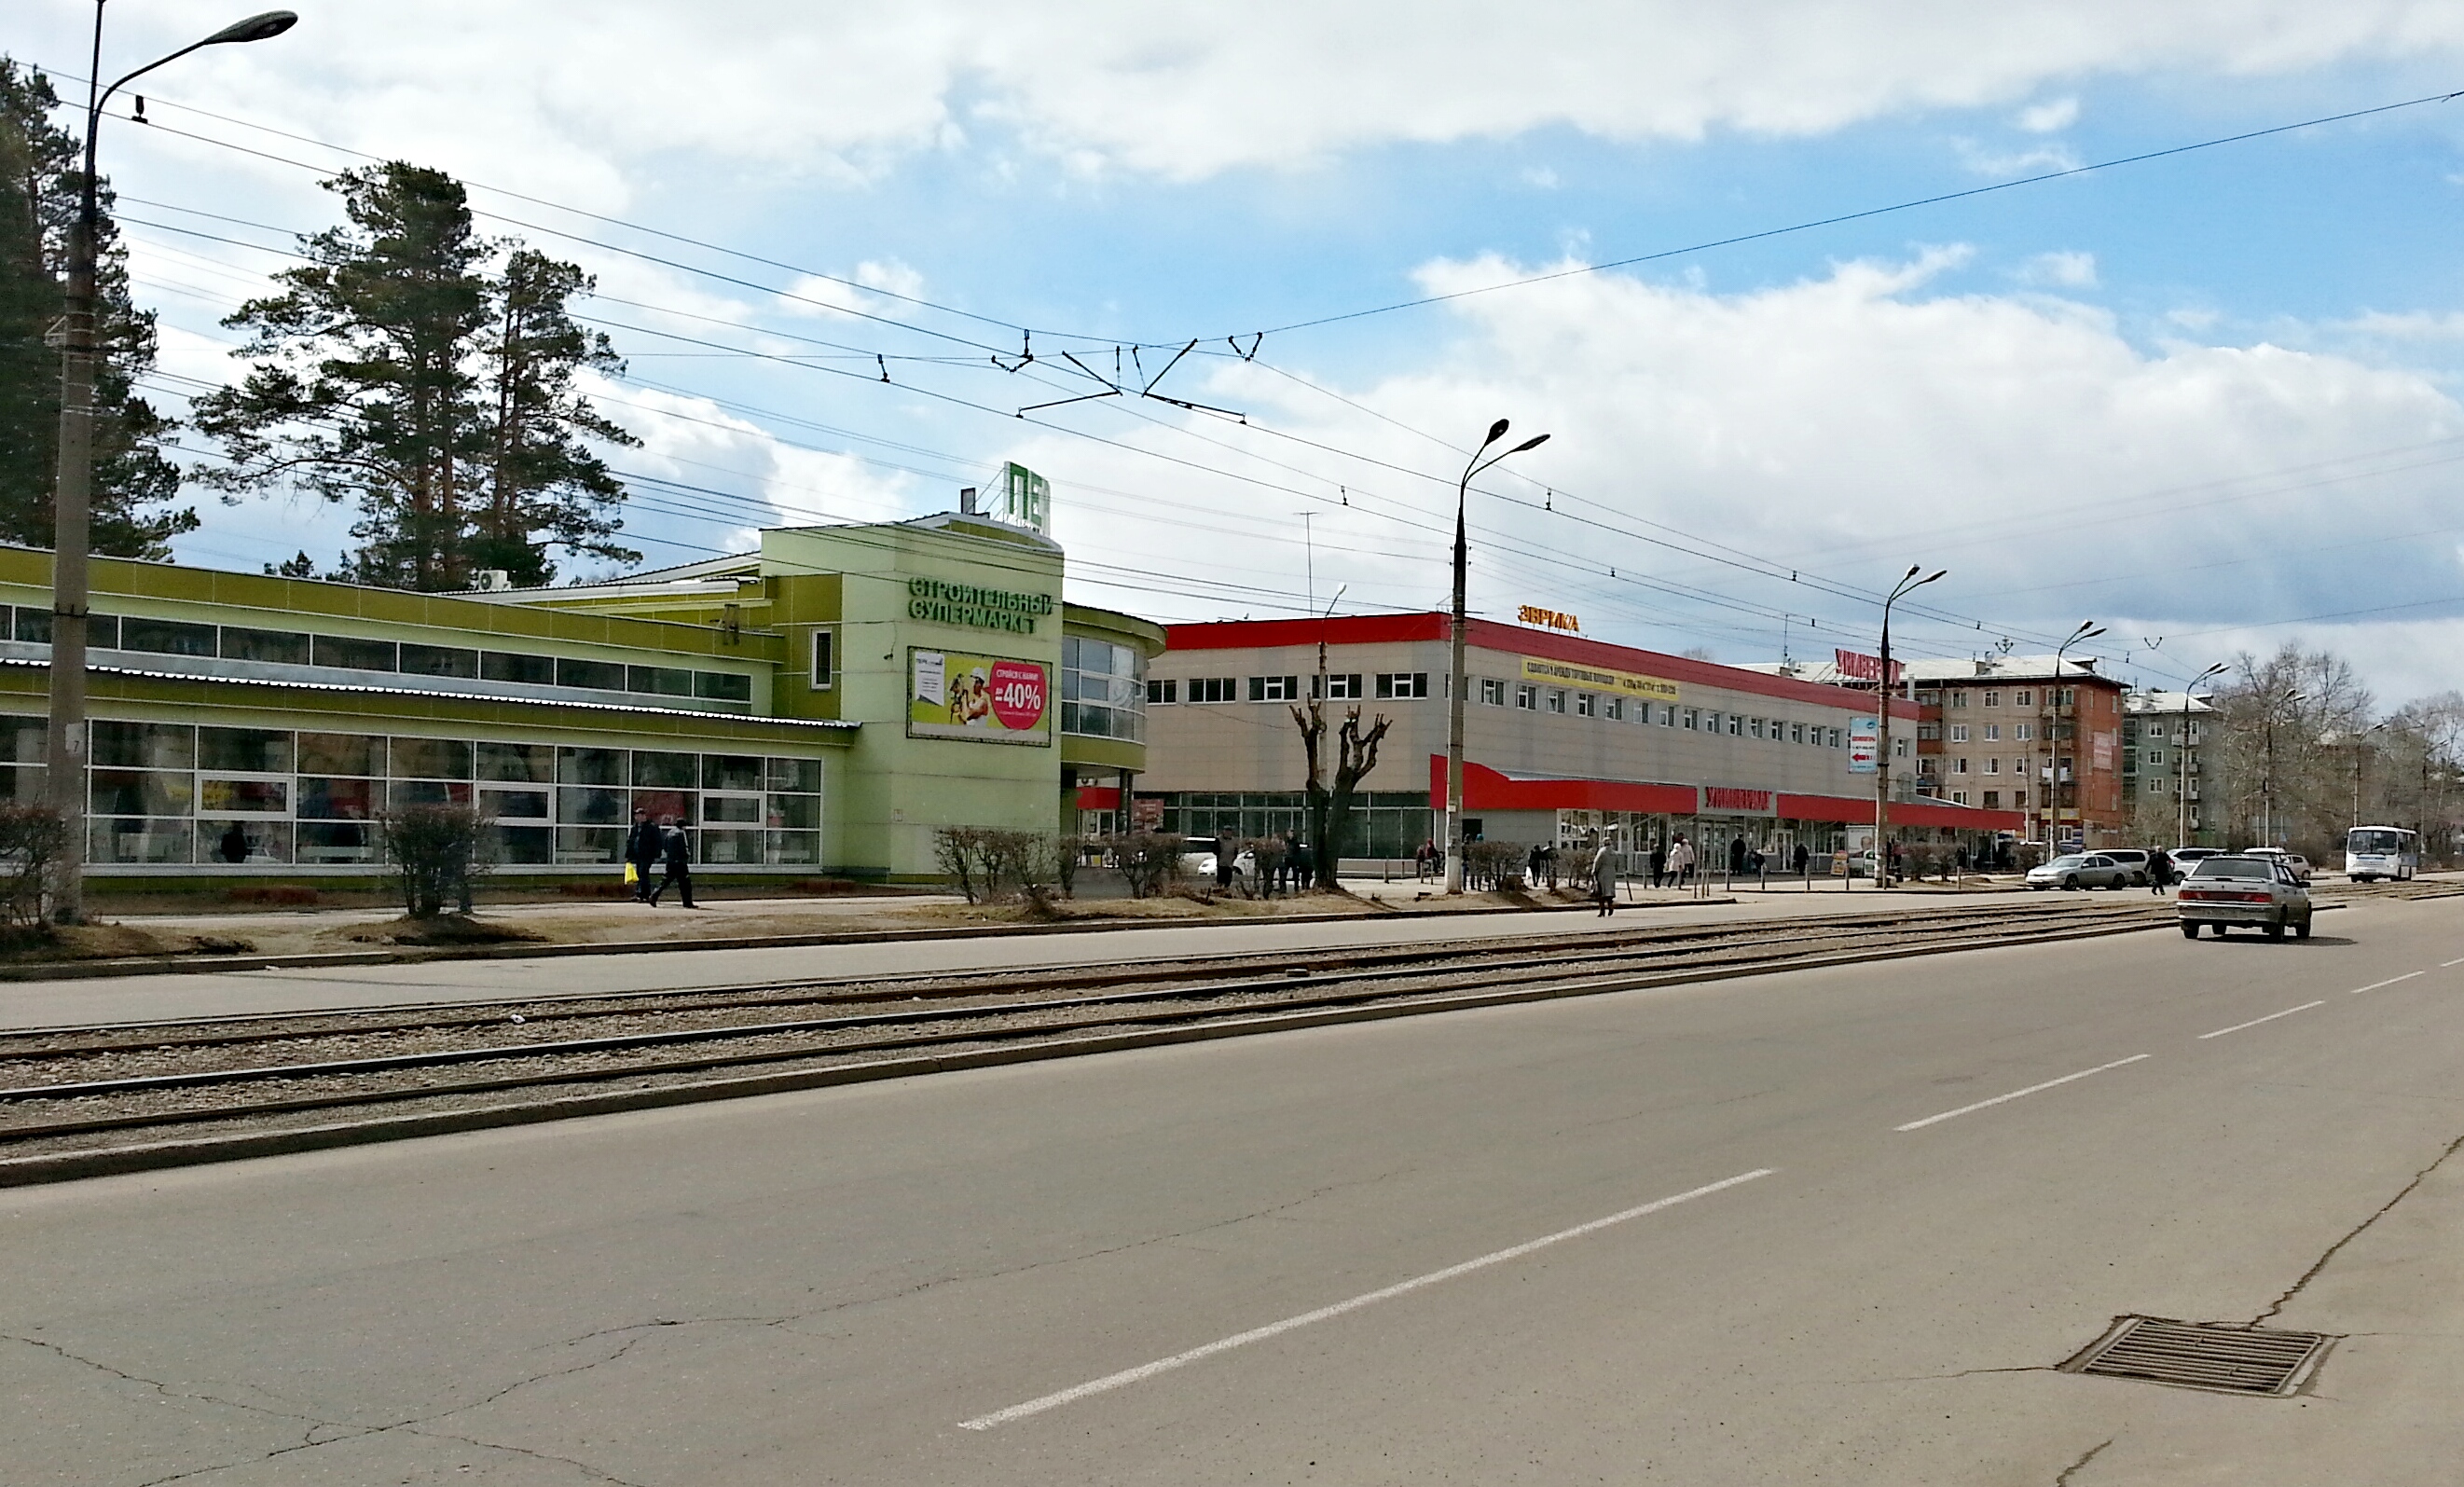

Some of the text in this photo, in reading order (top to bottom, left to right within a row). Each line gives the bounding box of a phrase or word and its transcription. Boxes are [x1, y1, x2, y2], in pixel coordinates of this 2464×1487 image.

[909, 577, 1053, 615] СТРОИТЕЛЬНЫЙ
[908, 599, 1036, 634] СУПЕРМАРКЕТ
[1518, 605, 1579, 632] ЭВРИКА
[1835, 648, 1906, 686] УНИВЕРАГ
[995, 682, 1041, 710] -40%
